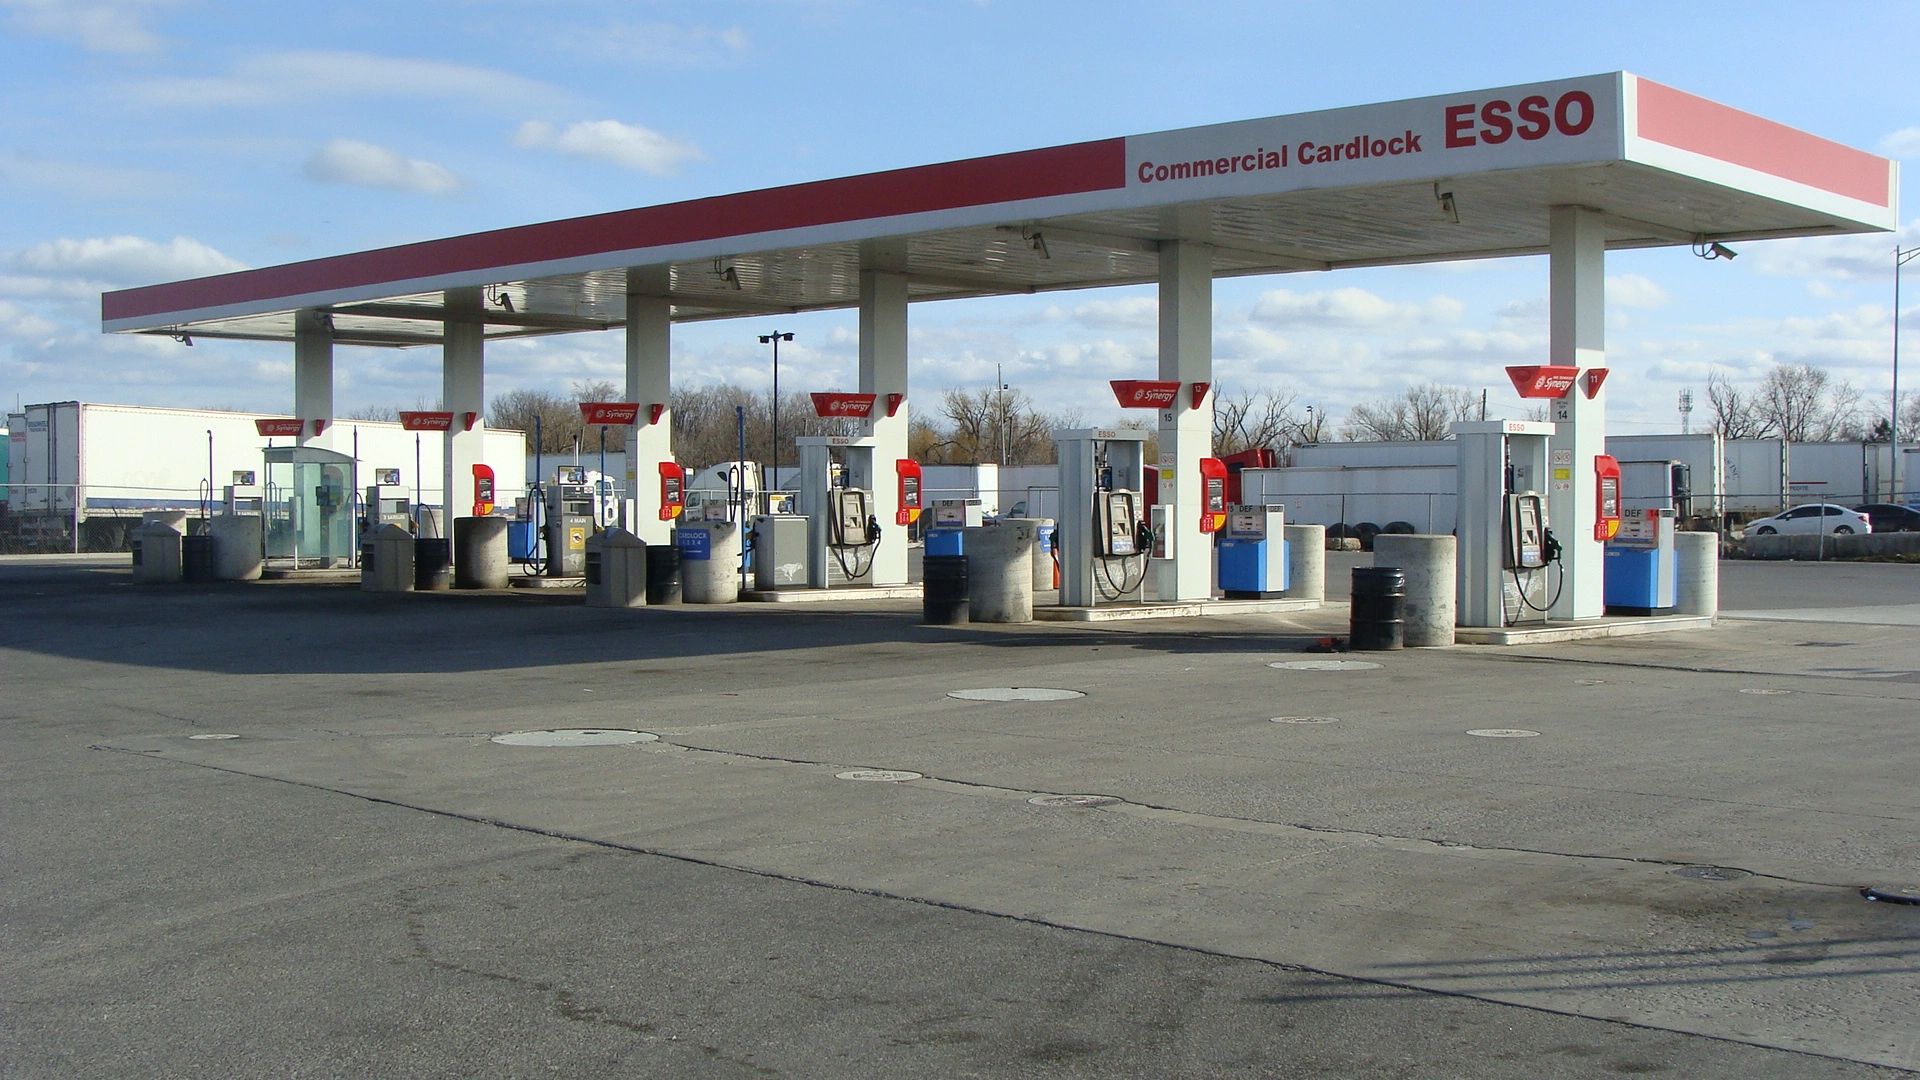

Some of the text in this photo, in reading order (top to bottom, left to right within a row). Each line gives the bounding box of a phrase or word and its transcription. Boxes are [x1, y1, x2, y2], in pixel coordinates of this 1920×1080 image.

[1445, 90, 1595, 149] ESSO
[1137, 130, 1423, 184] Commercial Cardlock
[1590, 375, 1598, 383] 11
[1544, 378, 1573, 391] Synergy
[1144, 390, 1175, 402] Synergy
[840, 402, 871, 412] Synergy
[606, 410, 635, 420] Synergy
[1163, 413, 1173, 422] 15
[1557, 410, 1568, 420] 14
[422, 418, 449, 427] Synergy
[1508, 423, 1526, 431] ESSO
[274, 425, 301, 433] Synergy
[1098, 430, 1116, 438] ESSO
[1624, 509, 1642, 518] DEF
